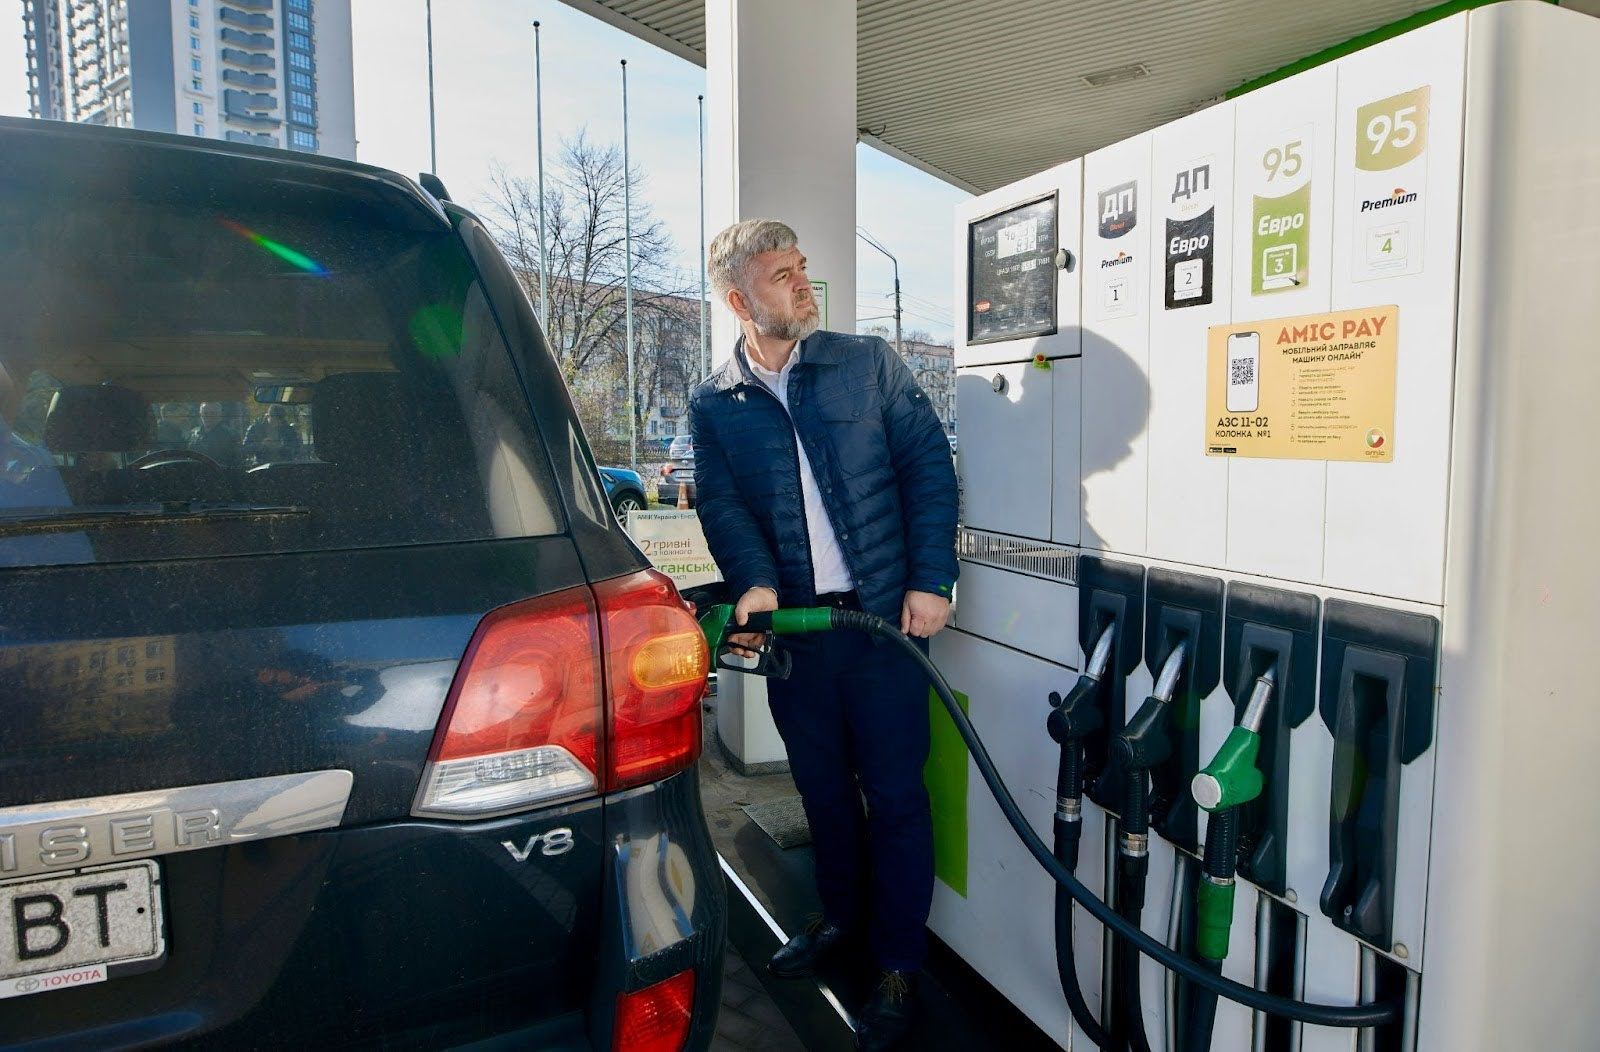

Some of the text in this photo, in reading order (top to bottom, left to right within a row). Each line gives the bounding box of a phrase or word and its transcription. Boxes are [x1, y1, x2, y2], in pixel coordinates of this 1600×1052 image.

[1366, 105, 1417, 155] 95
[1263, 140, 1302, 182] 95
[1171, 164, 1210, 203] ДП
[1102, 188, 1134, 224] ДП
[1361, 191, 1417, 212] Premium
[1257, 212, 1305, 237] Евро
[1169, 235, 1209, 257] Евро
[1381, 238, 1393, 254] 4
[1101, 254, 1133, 269] Premium
[1274, 257, 1284, 274] 3
[1185, 272, 1192, 285] 2
[1113, 289, 1119, 301] 1
[1276, 316, 1387, 345] AMIC PAY
[1282, 341, 1376, 355] МОБІЛЬНИЙ ЗАПРАВЛЯЄ
[1292, 355, 1326, 363] МАШИНУ
[1217, 417, 1269, 427] АЗС 11-02
[1215, 430, 1252, 438] КОЛОНКА
[641, 538, 691, 556] 2 гривні
[501, 827, 574, 862] V8
[41, 969, 101, 988] TOYOTA
